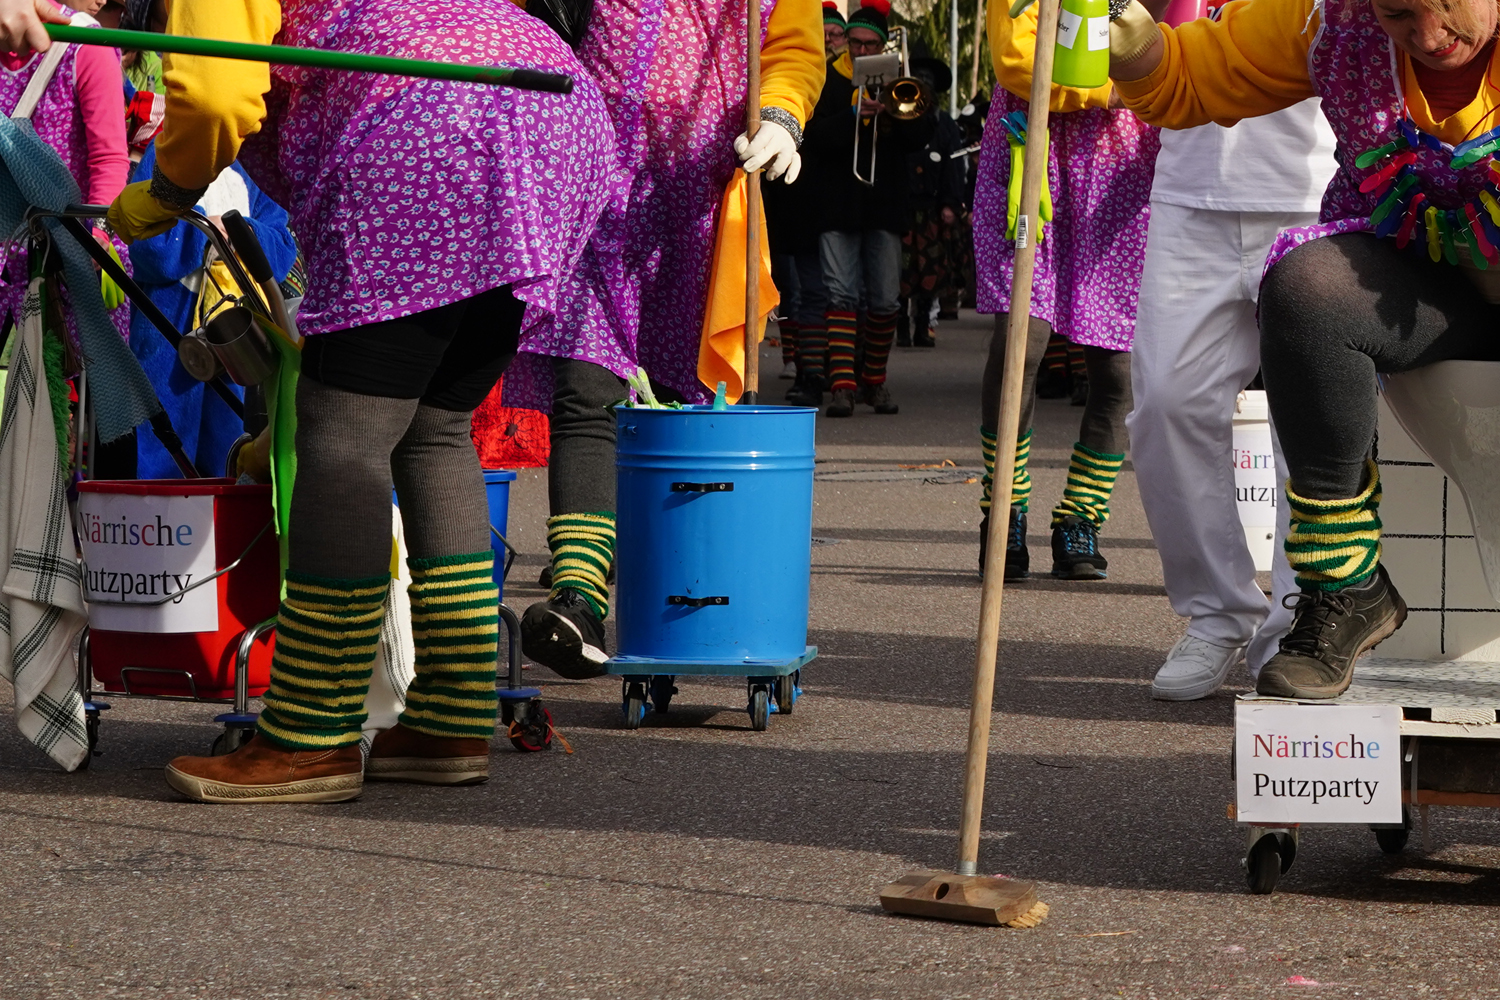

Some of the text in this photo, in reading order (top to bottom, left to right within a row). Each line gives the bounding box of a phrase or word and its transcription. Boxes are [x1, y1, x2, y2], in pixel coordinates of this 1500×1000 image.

[80, 511, 193, 547] Närrische
[1253, 733, 1380, 759] Närrische
[1253, 773, 1380, 805] Putzparty
